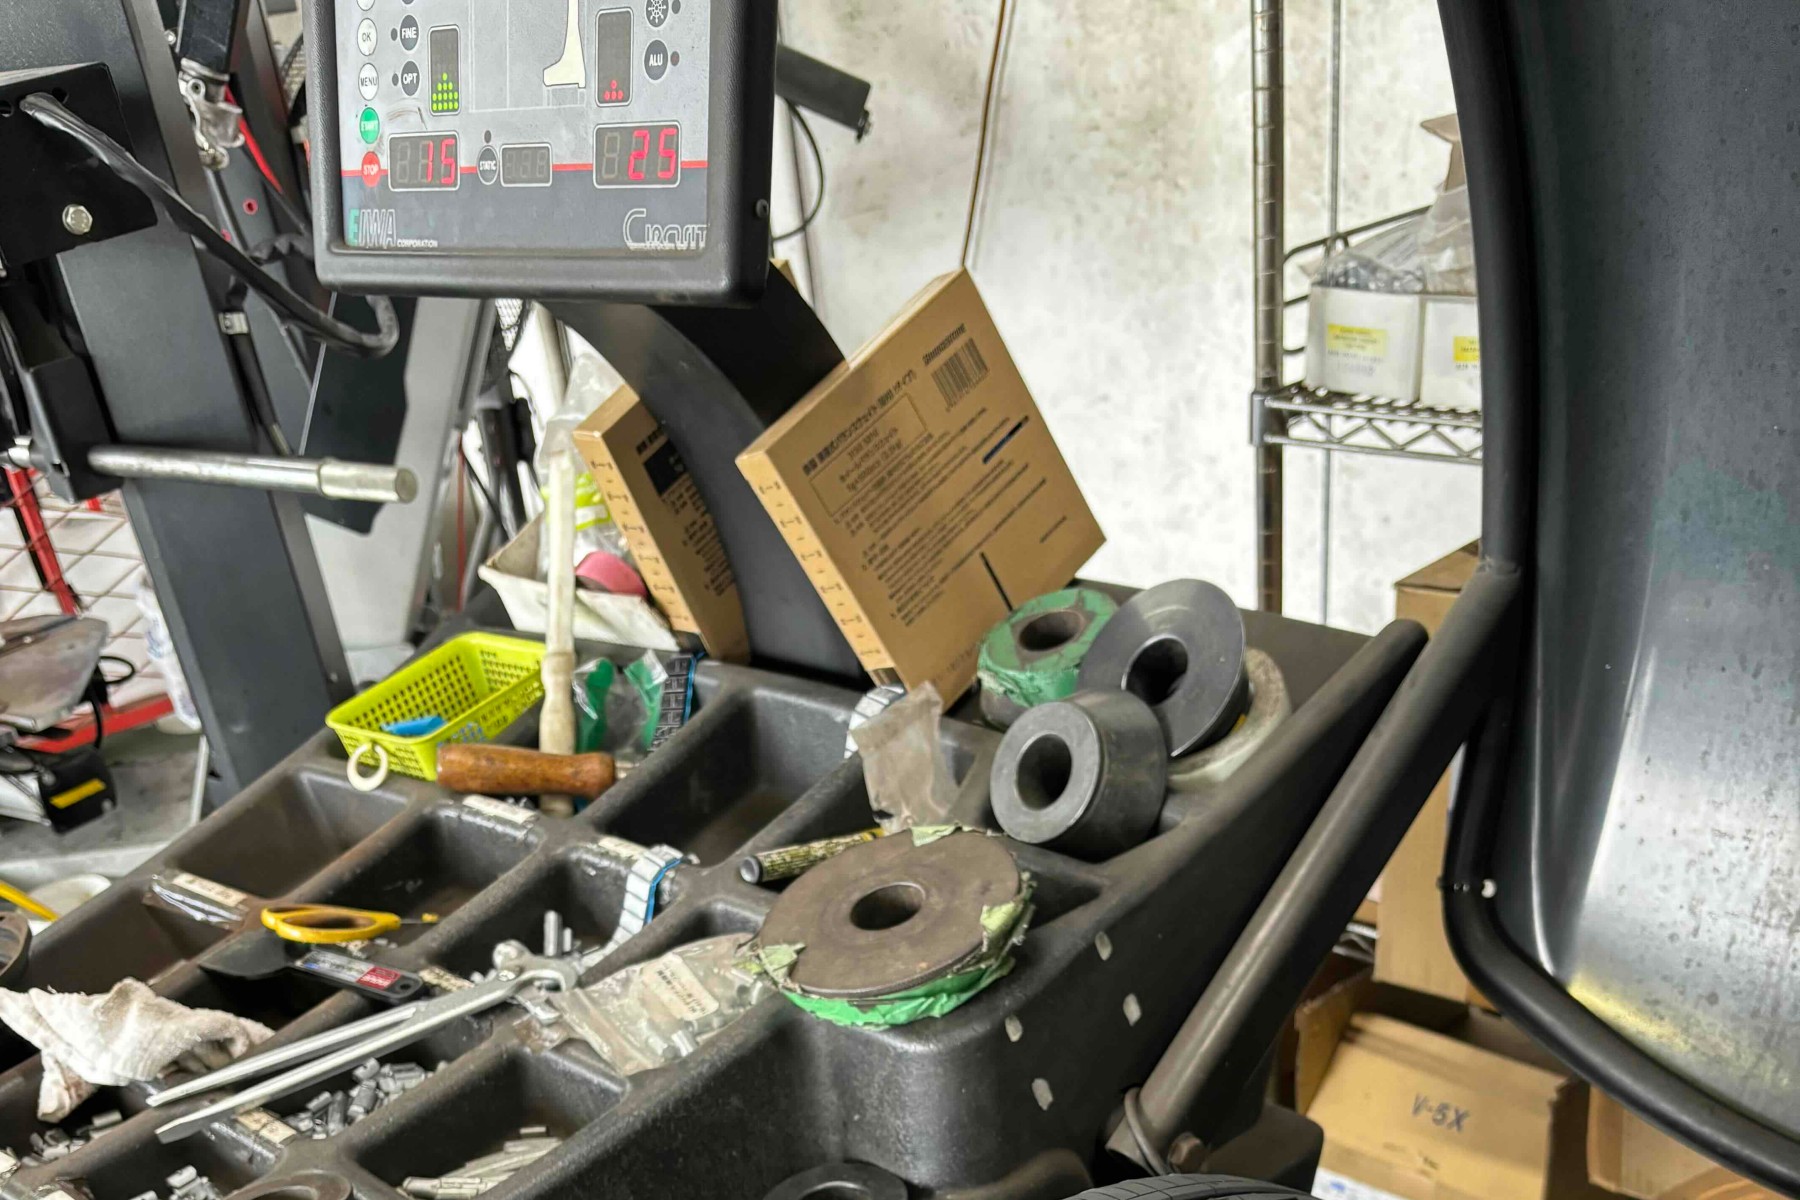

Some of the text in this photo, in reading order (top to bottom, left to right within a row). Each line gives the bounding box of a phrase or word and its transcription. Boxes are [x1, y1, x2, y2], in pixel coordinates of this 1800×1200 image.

[362, 32, 372, 42] OK
[401, 27, 417, 39] FINE
[649, 54, 663, 66] ALU
[360, 77, 378, 87] MENU
[403, 73, 418, 85] OPT
[628, 128, 677, 180] 25
[427, 138, 456, 185] 15
[479, 160, 496, 171] STATIC
[363, 164, 379, 175] STOP
[350, 209, 397, 248] EIWA
